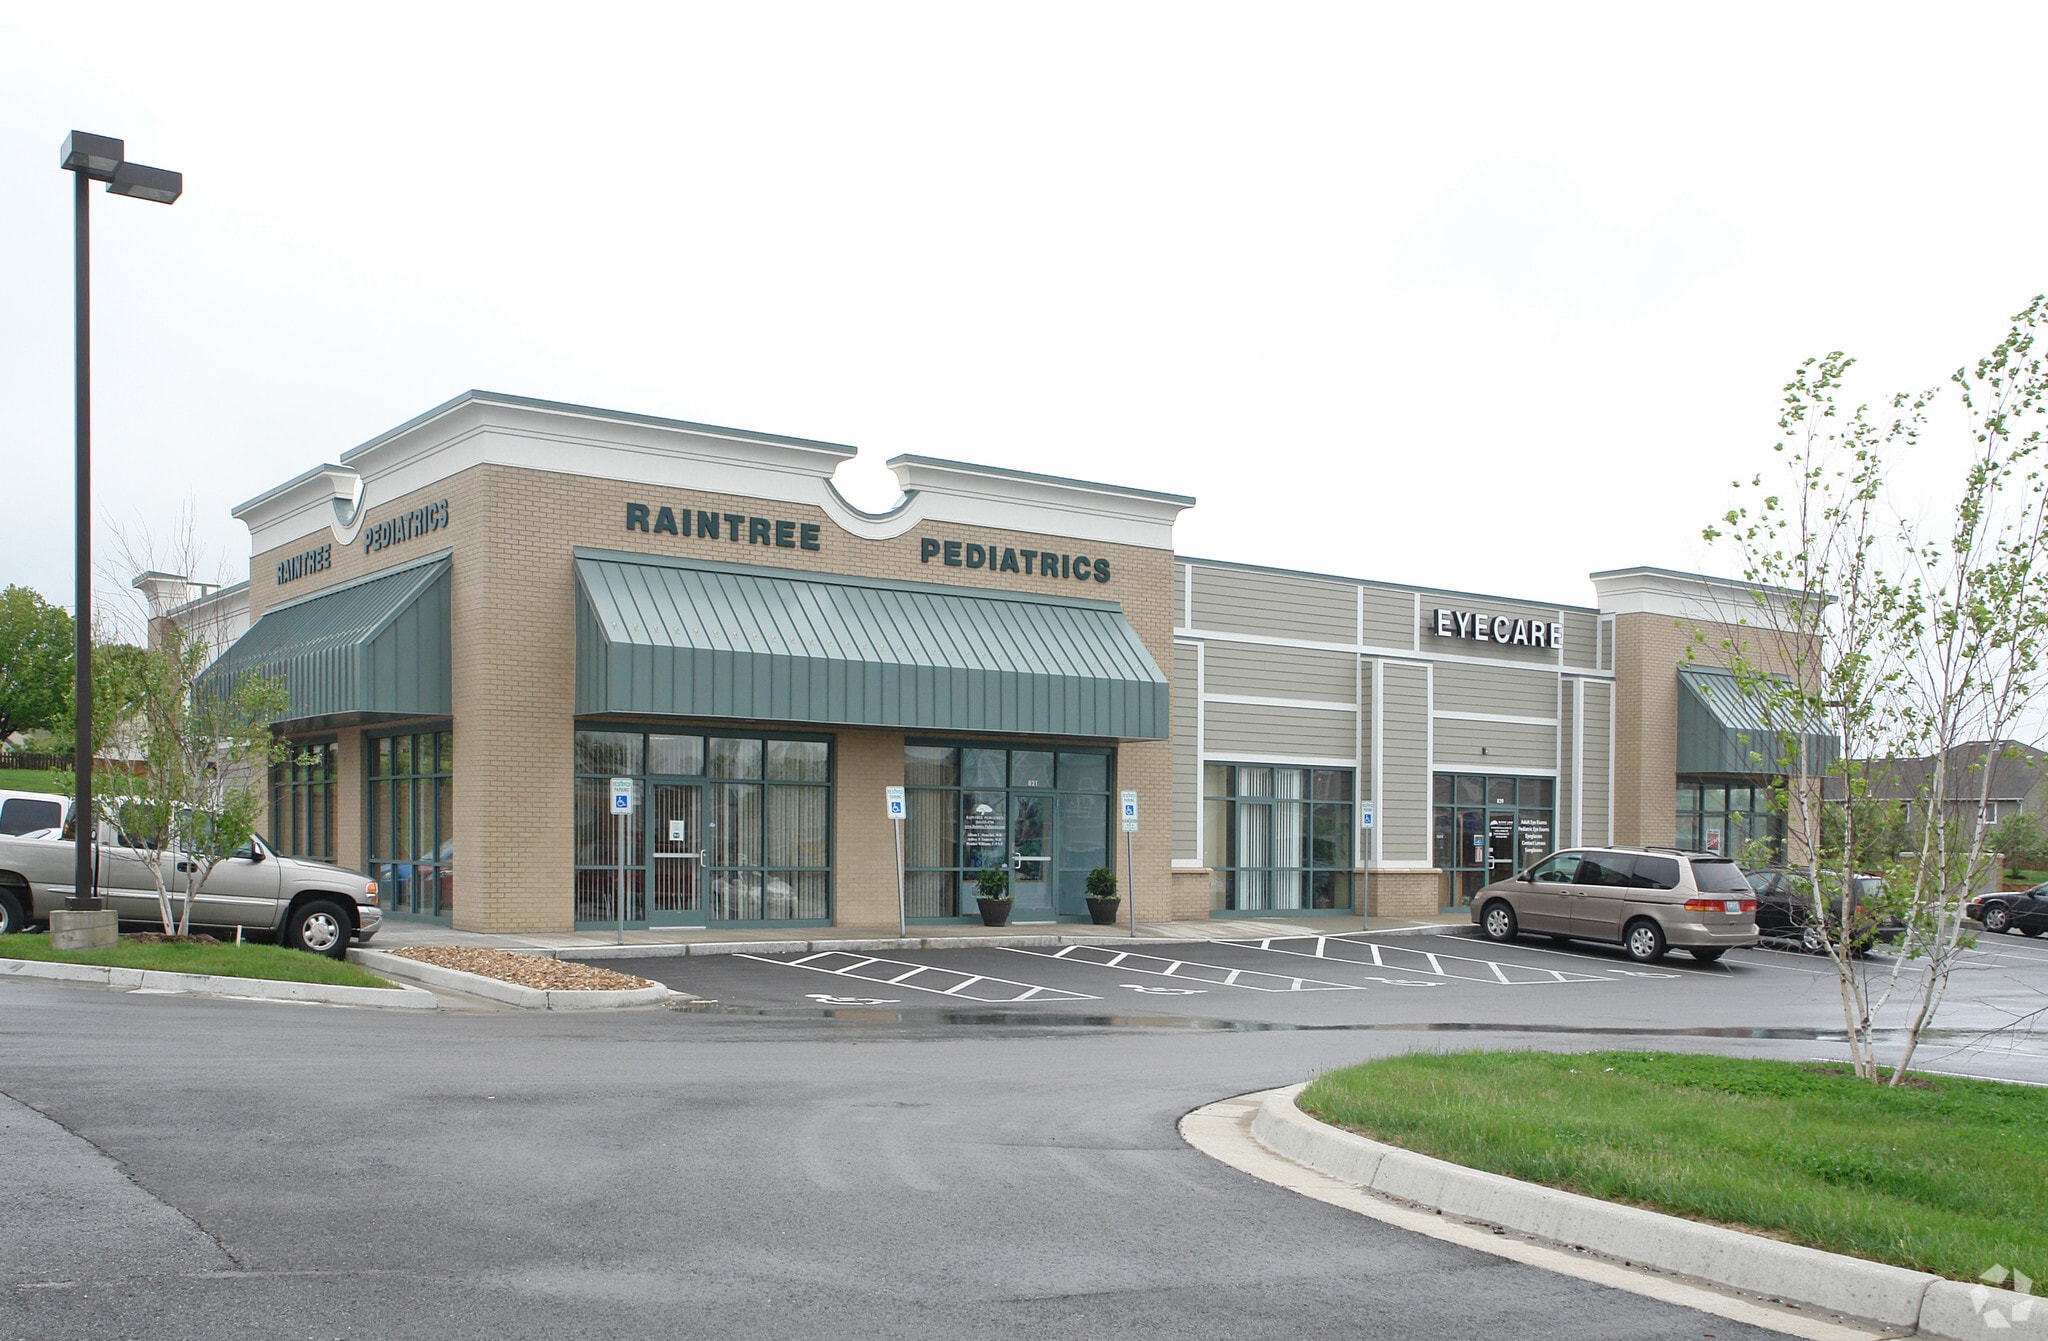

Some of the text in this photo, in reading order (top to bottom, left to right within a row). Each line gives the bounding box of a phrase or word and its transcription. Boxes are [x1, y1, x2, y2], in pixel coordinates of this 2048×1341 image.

[276, 498, 449, 585] RAINTREE PEDIATRICS
[625, 502, 1111, 584] RAINTREE PEDIATRICS
[1433, 608, 1563, 649] EYECARE
